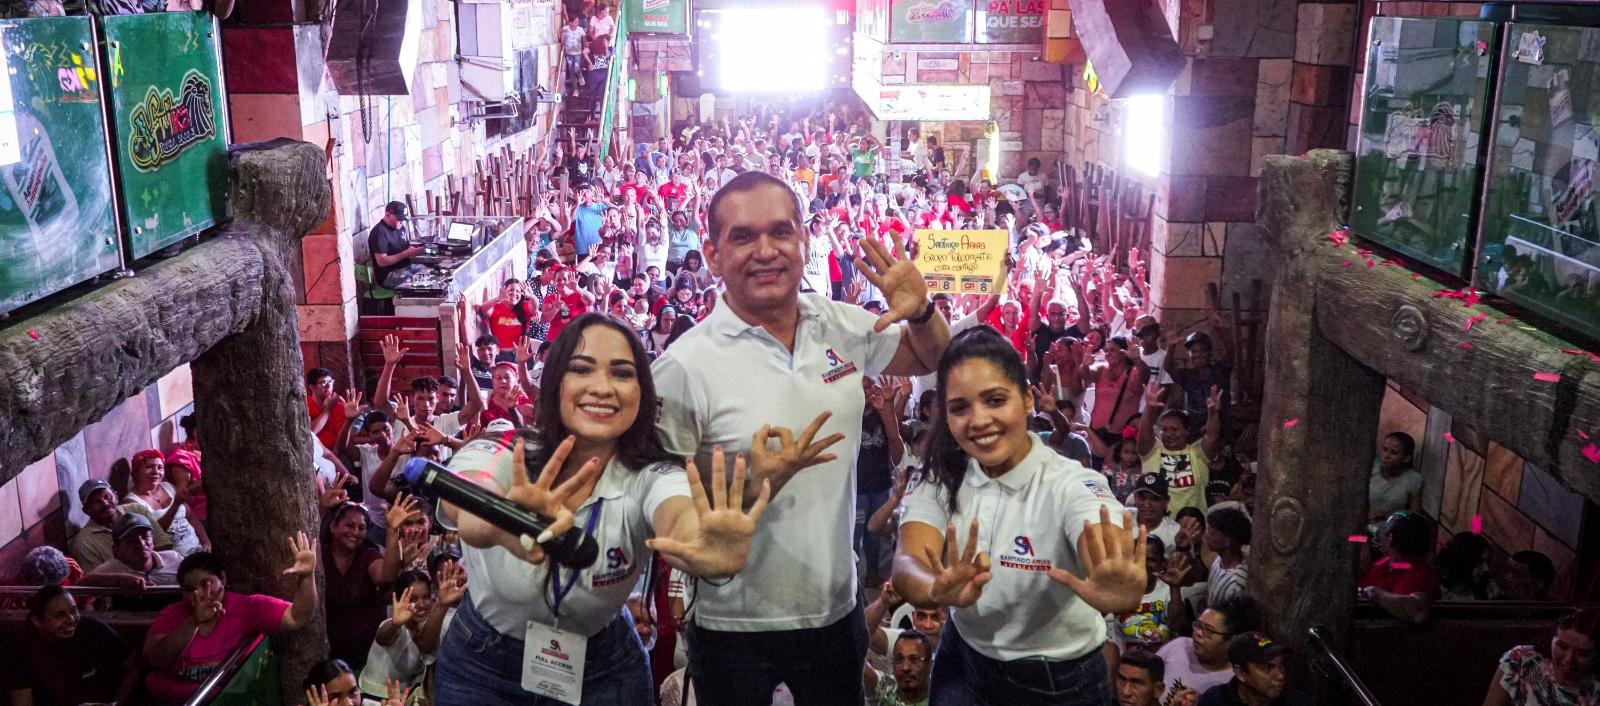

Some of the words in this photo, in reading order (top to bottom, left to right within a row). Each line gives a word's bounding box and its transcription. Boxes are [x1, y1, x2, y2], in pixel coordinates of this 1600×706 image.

[988, 16, 1018, 28] QUE
[943, 281, 950, 290] 8
[980, 282, 987, 292] 8
[1000, 554, 1031, 564] SANTIAGO
